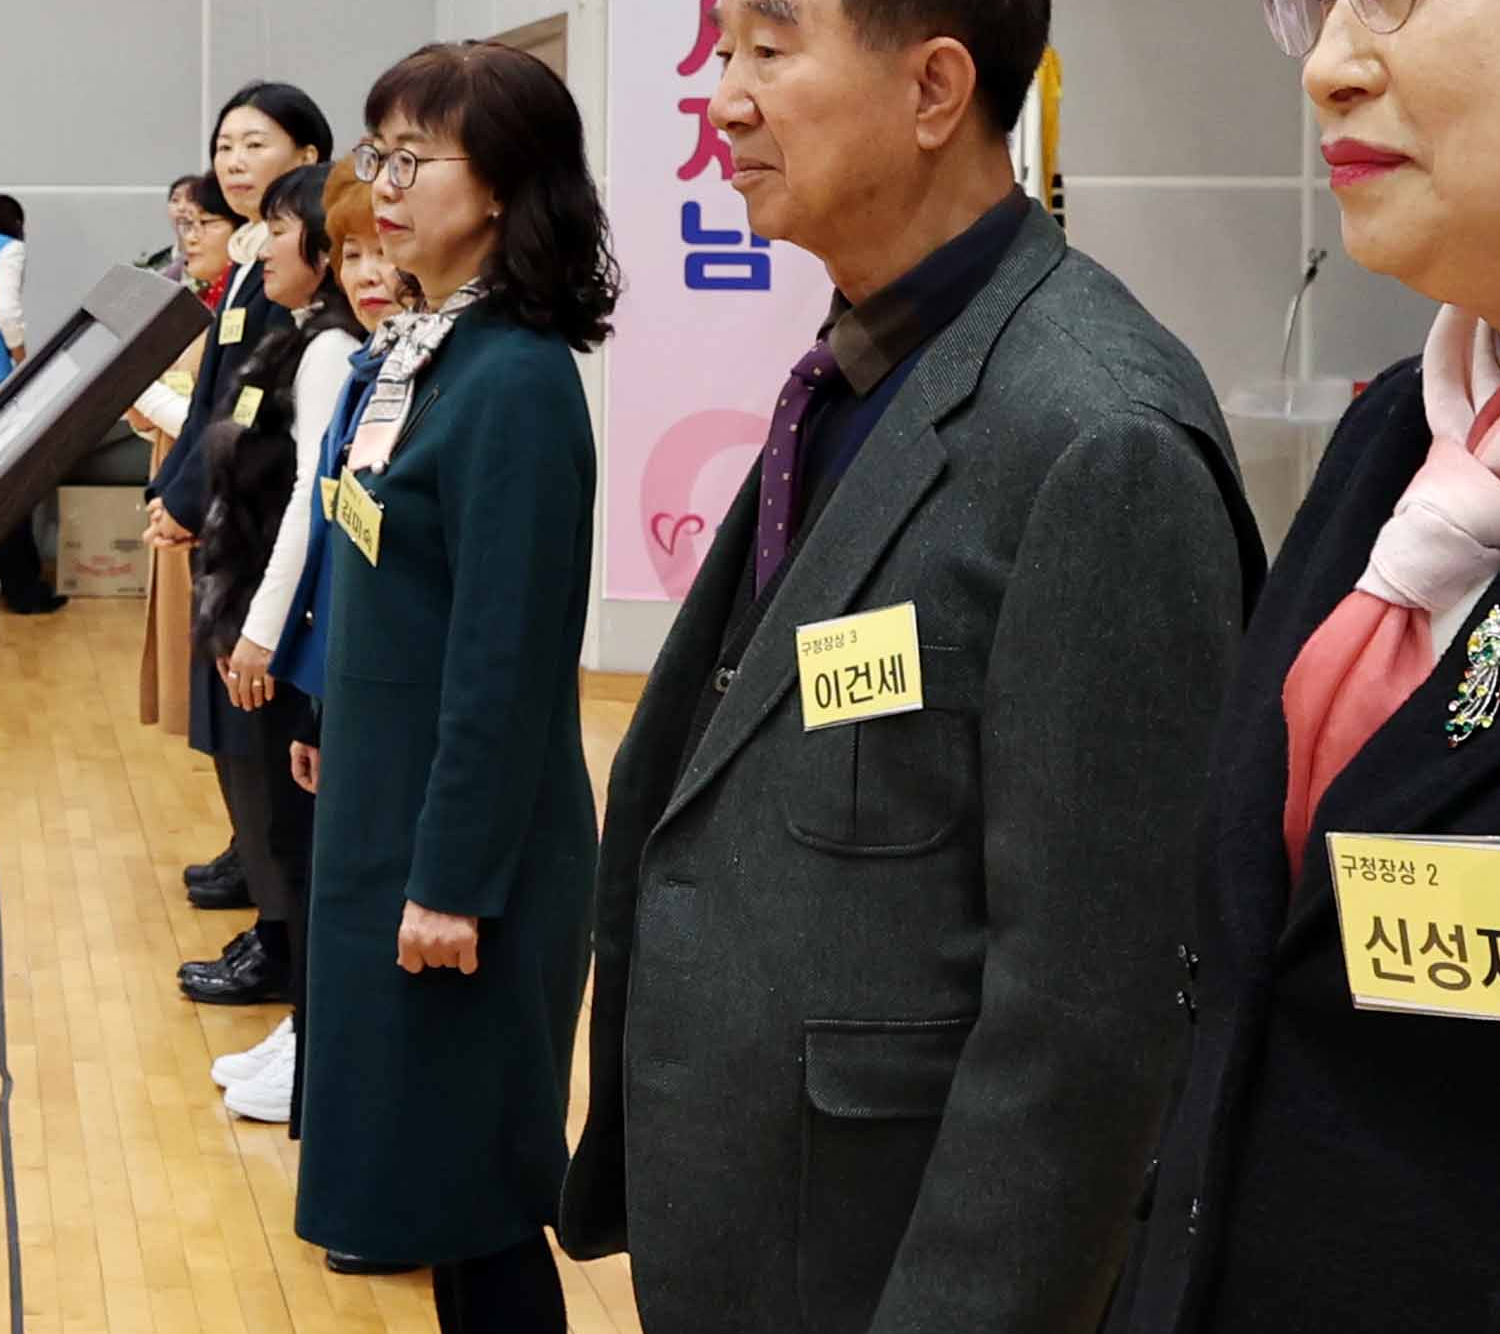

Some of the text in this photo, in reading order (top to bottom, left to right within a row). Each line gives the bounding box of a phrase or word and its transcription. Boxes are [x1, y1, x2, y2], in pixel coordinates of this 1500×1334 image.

[801, 629, 858, 657] 구청장상 3
[814, 653, 907, 710] 이건세
[1339, 854, 1440, 887] 구청장상 2
